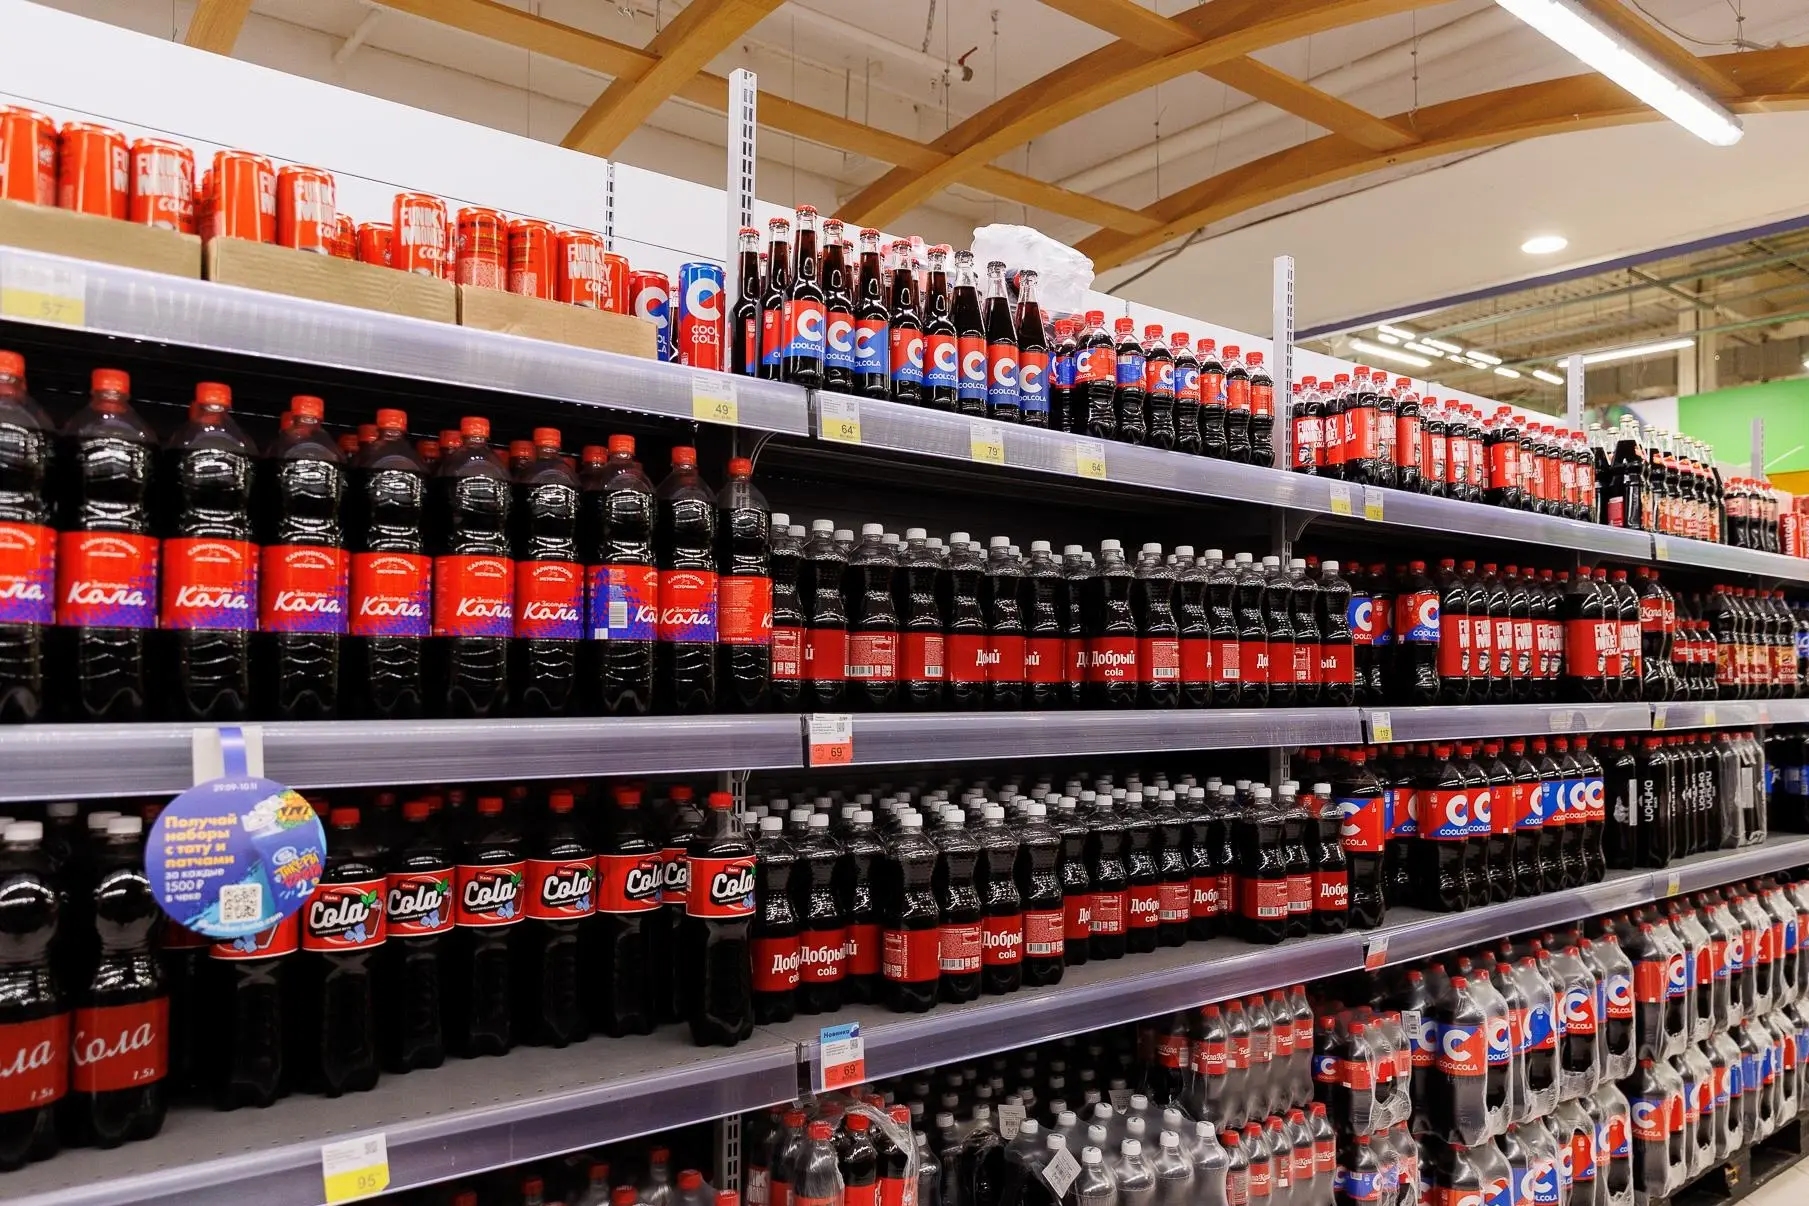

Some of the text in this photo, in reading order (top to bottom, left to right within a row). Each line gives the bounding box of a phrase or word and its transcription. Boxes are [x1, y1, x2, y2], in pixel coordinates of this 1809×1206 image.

[691, 324, 719, 337] COOL
[691, 334, 720, 345] COLA
[715, 403, 729, 416] 49
[840, 423, 855, 436] 64
[987, 445, 998, 457] 79
[67, 581, 147, 606] Кола
[175, 585, 249, 609] Кола
[273, 591, 342, 614] Кола
[359, 595, 424, 617] Кола
[456, 597, 513, 618] Кола
[523, 601, 579, 621] Кола
[660, 607, 711, 625] Кола
[1091, 649, 1136, 668] Добрый
[1104, 668, 1124, 677] cola
[831, 747, 842, 757] 69
[164, 813, 238, 831] Получай
[164, 829, 231, 843] наборы
[164, 843, 226, 856] с тату и
[164, 855, 235, 869] патчами
[164, 868, 225, 880] за каждые
[165, 881, 195, 893] 1500
[464, 877, 517, 906] Cola
[543, 871, 592, 900] Cola
[711, 869, 755, 898] Cola
[387, 885, 443, 915] Cola
[310, 897, 370, 929] Cola
[982, 931, 1022, 949] Добры
[771, 951, 800, 974] Добр
[800, 945, 846, 966] Добры
[997, 949, 1017, 960] cola
[816, 965, 838, 977] cola
[843, 1063, 856, 1076] 69
[1439, 1060, 1478, 1071] COOLCOLA
[357, 1173, 376, 1190] 95
